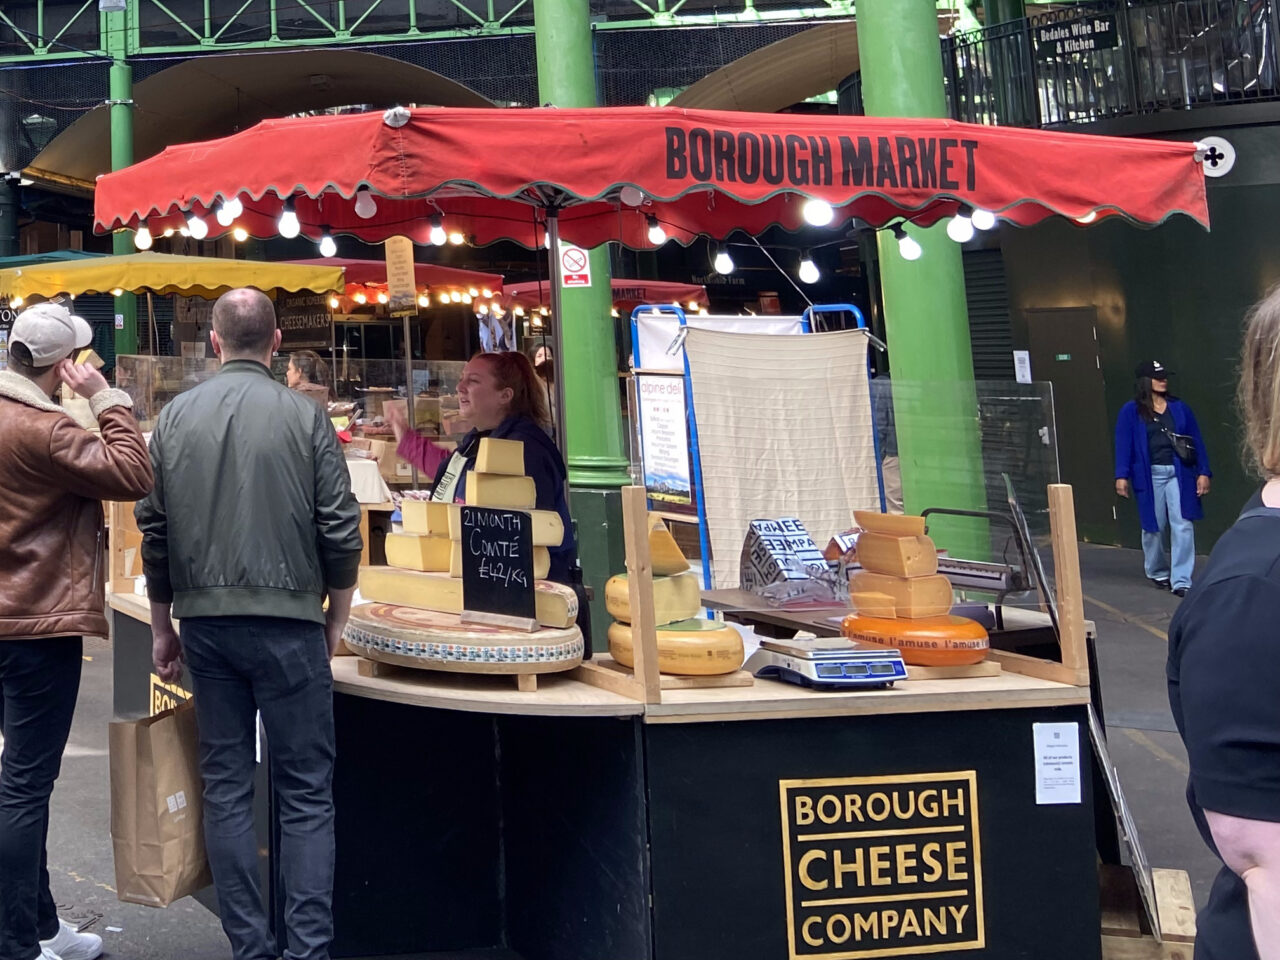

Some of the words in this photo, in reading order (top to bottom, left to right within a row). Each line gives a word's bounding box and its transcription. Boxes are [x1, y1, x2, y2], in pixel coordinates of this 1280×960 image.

[1040, 26, 1069, 42] Bedales
[1071, 22, 1092, 37] Wine
[1094, 20, 1110, 33] Bar
[1056, 41, 1062, 54] &
[1064, 38, 1095, 53] Kitchen
[665, 127, 832, 186] BOROUGH
[839, 136, 978, 191] MARKET
[611, 288, 646, 300] MARKET
[280, 313, 330, 330] CHEESEMAKERS
[641, 382, 666, 395] alpine
[666, 383, 682, 396] deli
[464, 509, 474, 526] 21
[478, 511, 521, 531] MONTH
[889, 637, 938, 649] l'amuse
[945, 640, 980, 649] l'amuse
[795, 788, 965, 826] BOROUGH
[798, 841, 969, 891] CHEESE
[801, 904, 970, 947] COMPANY
